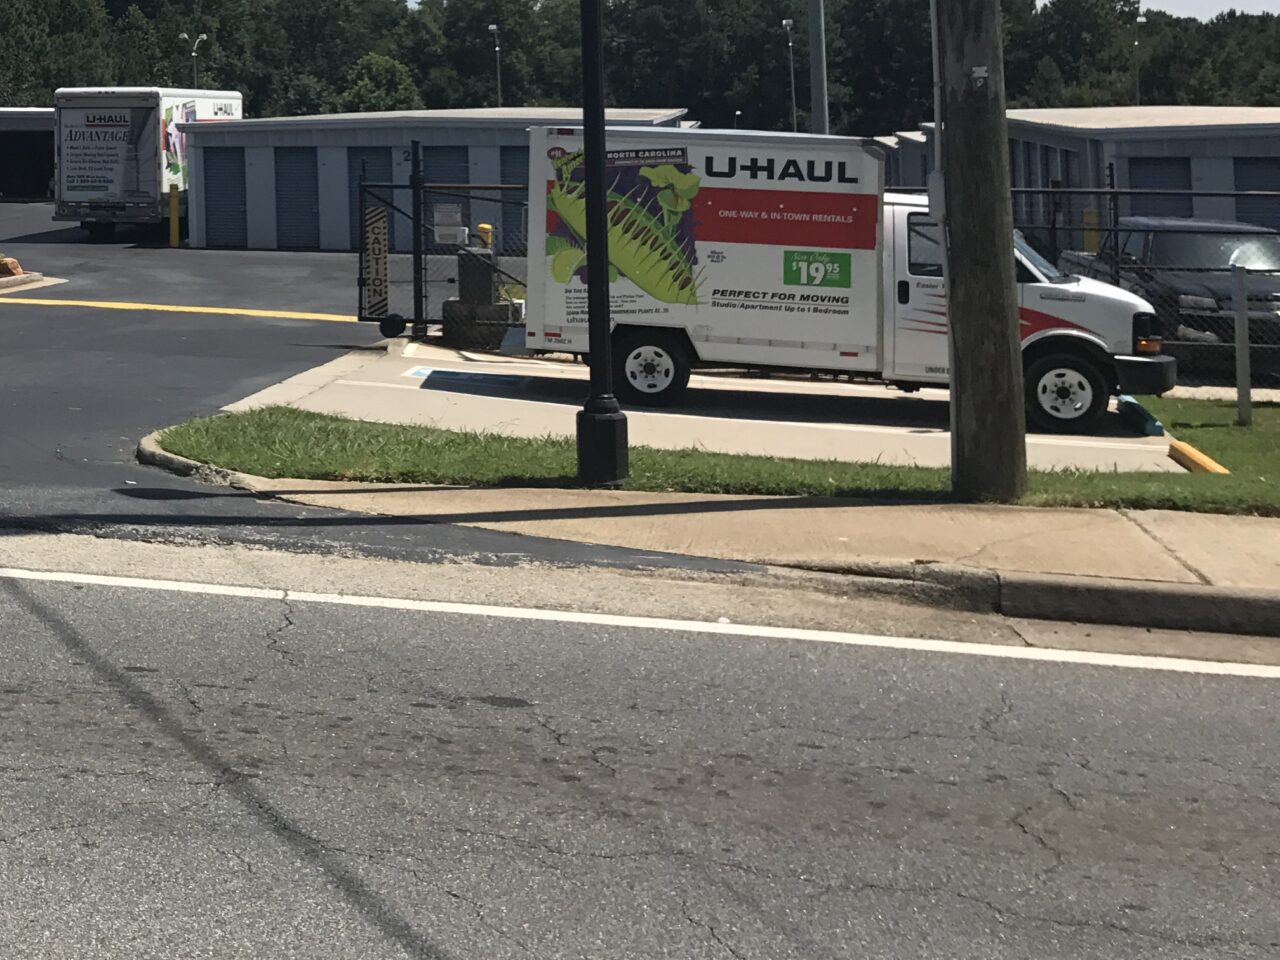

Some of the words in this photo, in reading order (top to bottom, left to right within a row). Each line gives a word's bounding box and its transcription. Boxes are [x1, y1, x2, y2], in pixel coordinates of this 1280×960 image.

[86, 115, 129, 123] U-HAUL
[607, 151, 636, 159] NORTH
[638, 149, 683, 158] CAROLINA
[705, 156, 859, 184] U-HAUL
[718, 210, 759, 219] ONE-WAY
[761, 211, 767, 219] &
[770, 212, 810, 221] IN-TOWN
[812, 214, 854, 223] RENTALS
[371, 225, 384, 298] CAUTION
[711, 289, 768, 300] PERFECT
[770, 292, 795, 302] FOR
[799, 294, 850, 304] MOVING
[711, 301, 783, 312] Studio/Apartment
[784, 305, 796, 314] Up
[812, 307, 850, 315] Bedroom
